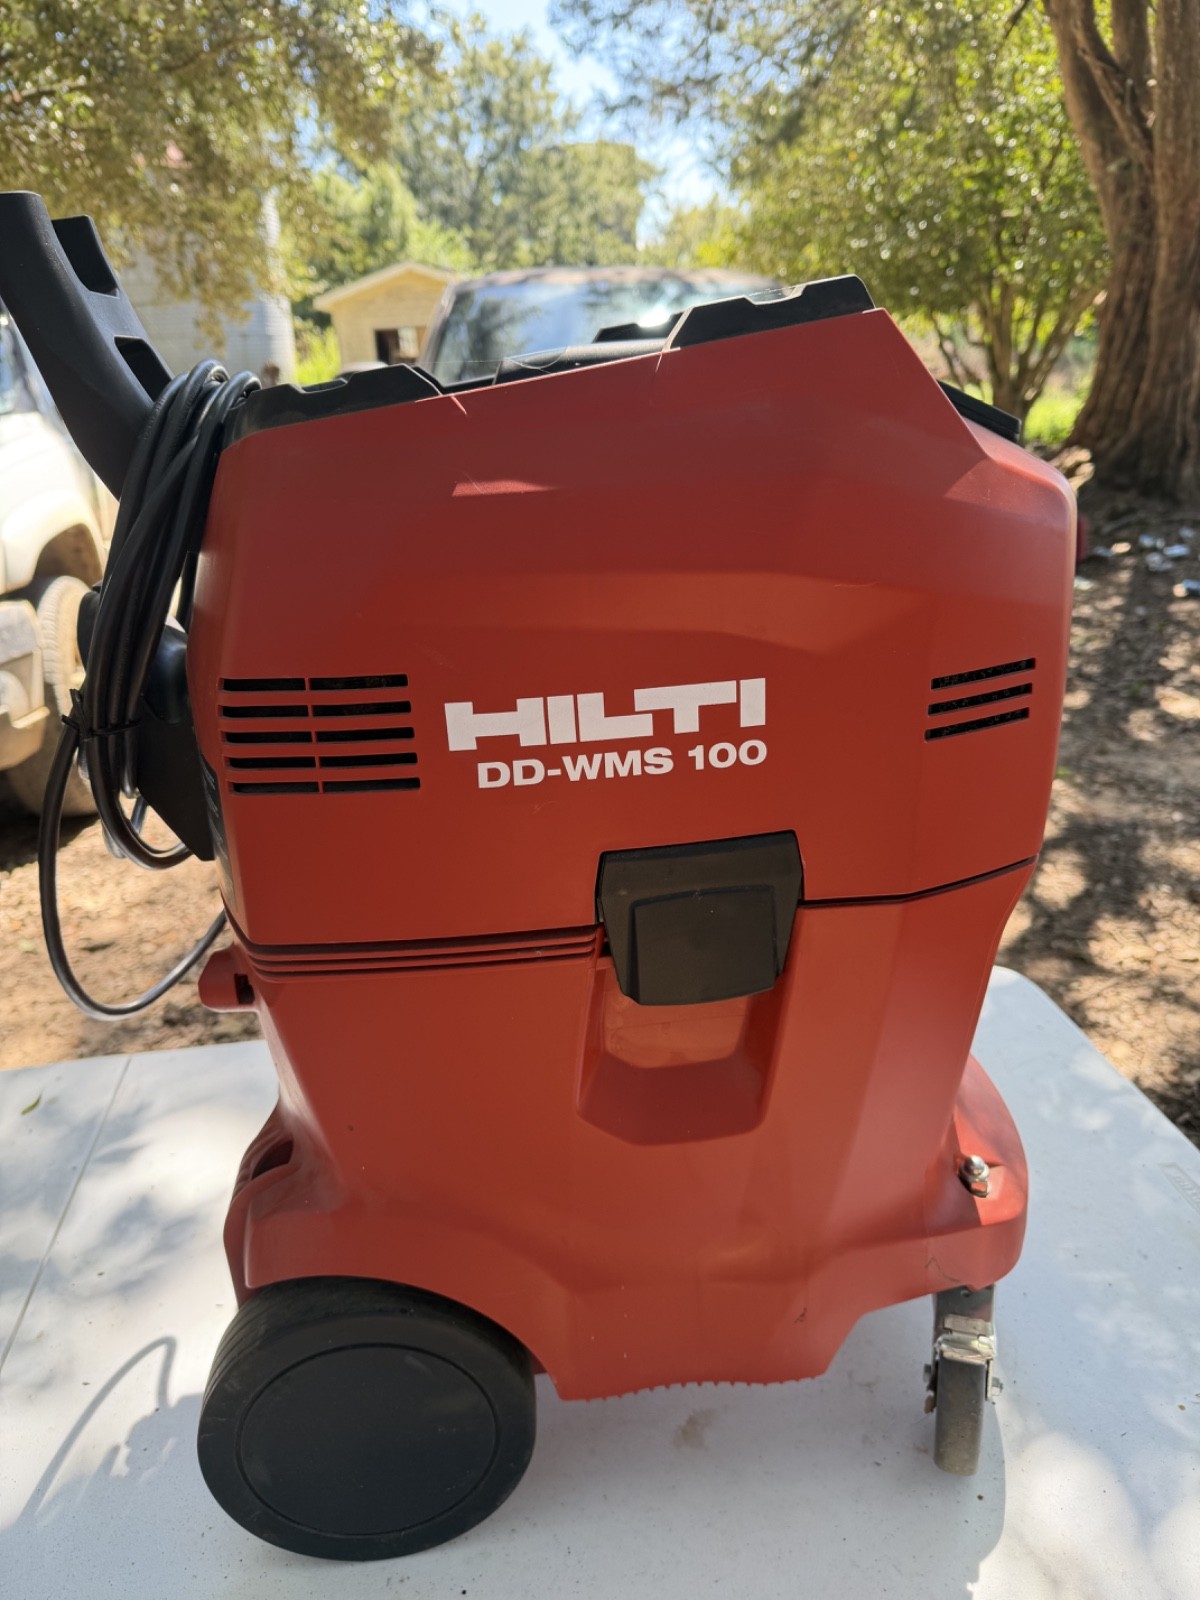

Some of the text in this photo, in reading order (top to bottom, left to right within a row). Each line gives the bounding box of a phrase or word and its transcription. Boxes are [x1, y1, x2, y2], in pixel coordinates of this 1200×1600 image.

[444, 678, 766, 751] HILTI
[477, 739, 768, 788] DD-WMS 100
